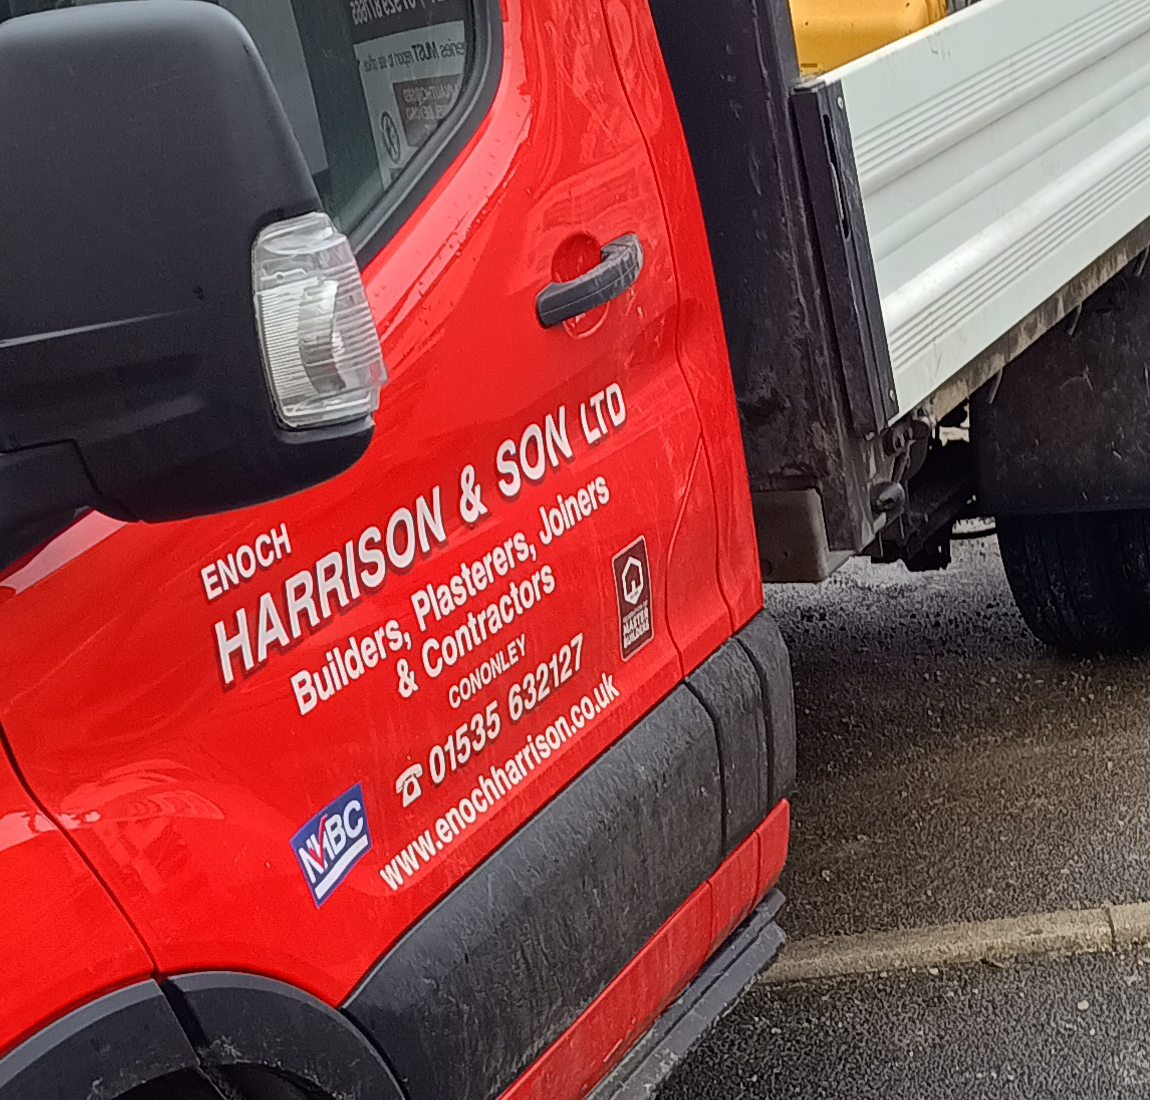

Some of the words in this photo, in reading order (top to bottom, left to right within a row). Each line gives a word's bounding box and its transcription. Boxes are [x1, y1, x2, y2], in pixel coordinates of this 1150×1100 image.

[200, 523, 292, 600] ENOCH
[213, 486, 448, 686] HARRISON
[459, 463, 488, 524] &
[495, 405, 574, 499] SON
[580, 382, 627, 445] LTD
[290, 618, 412, 716] Builders,
[411, 530, 538, 631] Plasterers,
[538, 475, 611, 546] Joiners
[397, 658, 418, 698] &
[421, 564, 556, 678] Contractors
[448, 633, 527, 709] CONONLEY
[379, 672, 621, 891] www.enochharrison.co.uk
[429, 700, 502, 786] 01535
[508, 632, 584, 722] 632127
